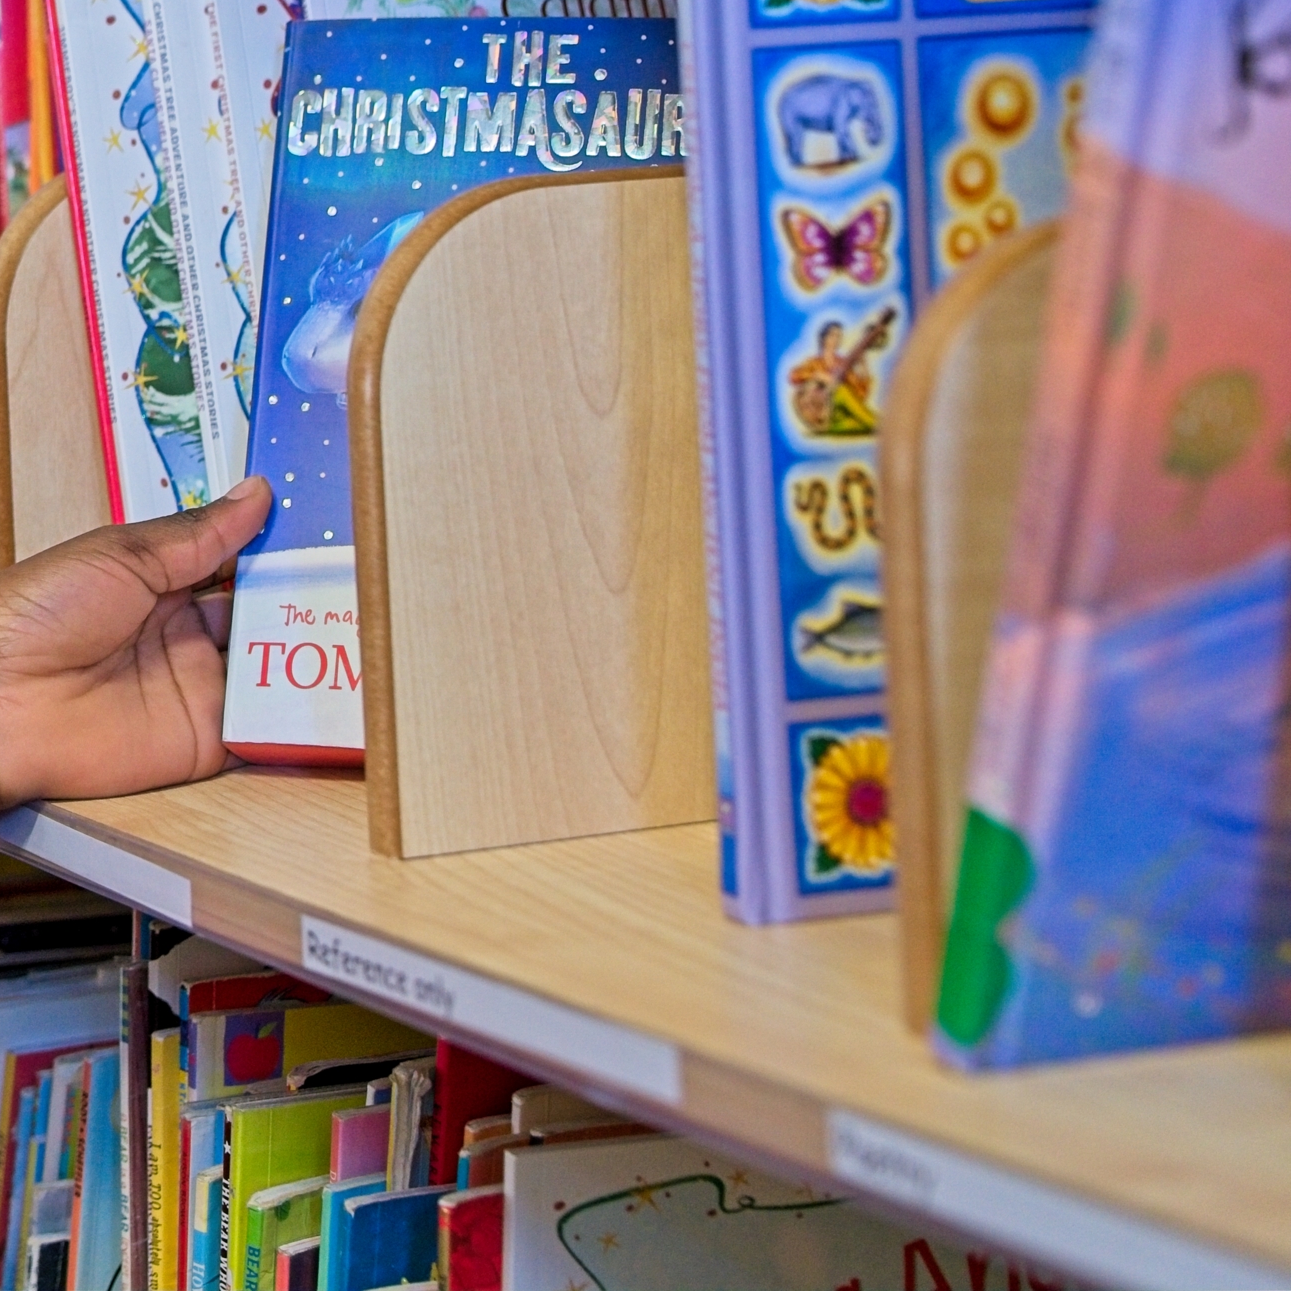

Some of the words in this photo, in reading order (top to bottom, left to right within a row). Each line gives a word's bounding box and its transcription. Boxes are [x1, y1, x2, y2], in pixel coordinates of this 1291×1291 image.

[207, 2, 219, 29] THE
[144, 19, 158, 64] SANTA
[152, 2, 174, 85] CHRISTMAS
[211, 31, 224, 71] FIRST
[482, 30, 580, 87] THE
[164, 87, 177, 123] TREE
[217, 74, 236, 157] CHRISTMAS
[158, 120, 174, 183] HELPERS
[170, 126, 189, 209] ADVENTURE
[229, 160, 241, 196] TREE
[165, 187, 178, 217] AND
[235, 199, 245, 229] AND
[80, 197, 92, 227] AND
[86, 229, 99, 275] OTHER
[171, 218, 184, 264] OTHER
[181, 213, 193, 243] AND
[186, 245, 200, 292] OTHER
[239, 231, 253, 278] OTHER
[178, 267, 196, 349] CHRISTMAS
[192, 295, 212, 377] CHRISTMAS
[190, 353, 206, 413] STORIES
[204, 381, 221, 441] STORIES
[278, 603, 316, 627] The
[247, 641, 363, 692] TOM
[306, 929, 408, 996] Reference
[415, 975, 455, 1021] only
[150, 1155, 159, 1177] am
[150, 1184, 162, 1211] TOO
[221, 1178, 230, 1207] THE
[220, 1210, 230, 1251] BEAR
[245, 1245, 261, 1291] BEAR
